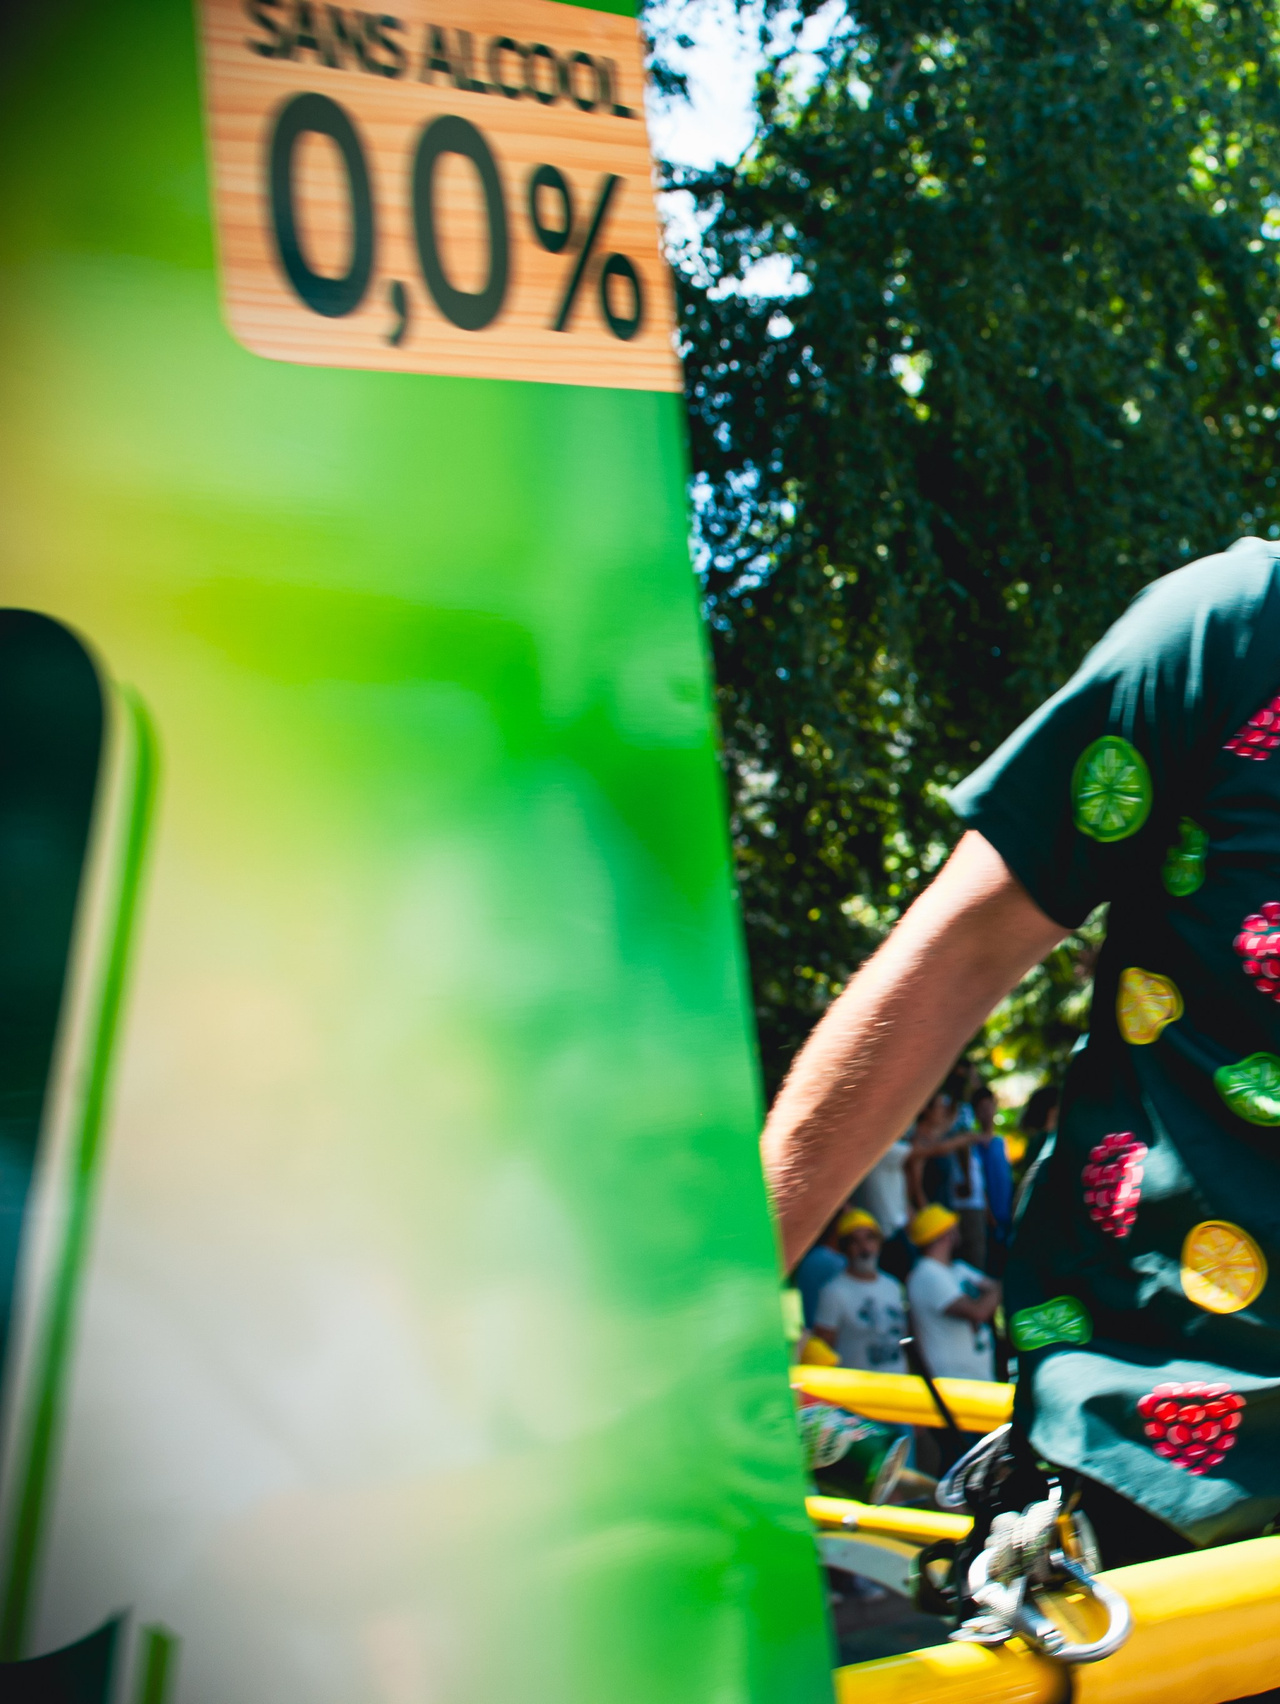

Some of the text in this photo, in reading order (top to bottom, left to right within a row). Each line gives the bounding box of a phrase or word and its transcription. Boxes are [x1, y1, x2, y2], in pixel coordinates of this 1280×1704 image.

[244, 0, 639, 120] SANS ALCOOL
[266, 91, 644, 348] 0,0%
